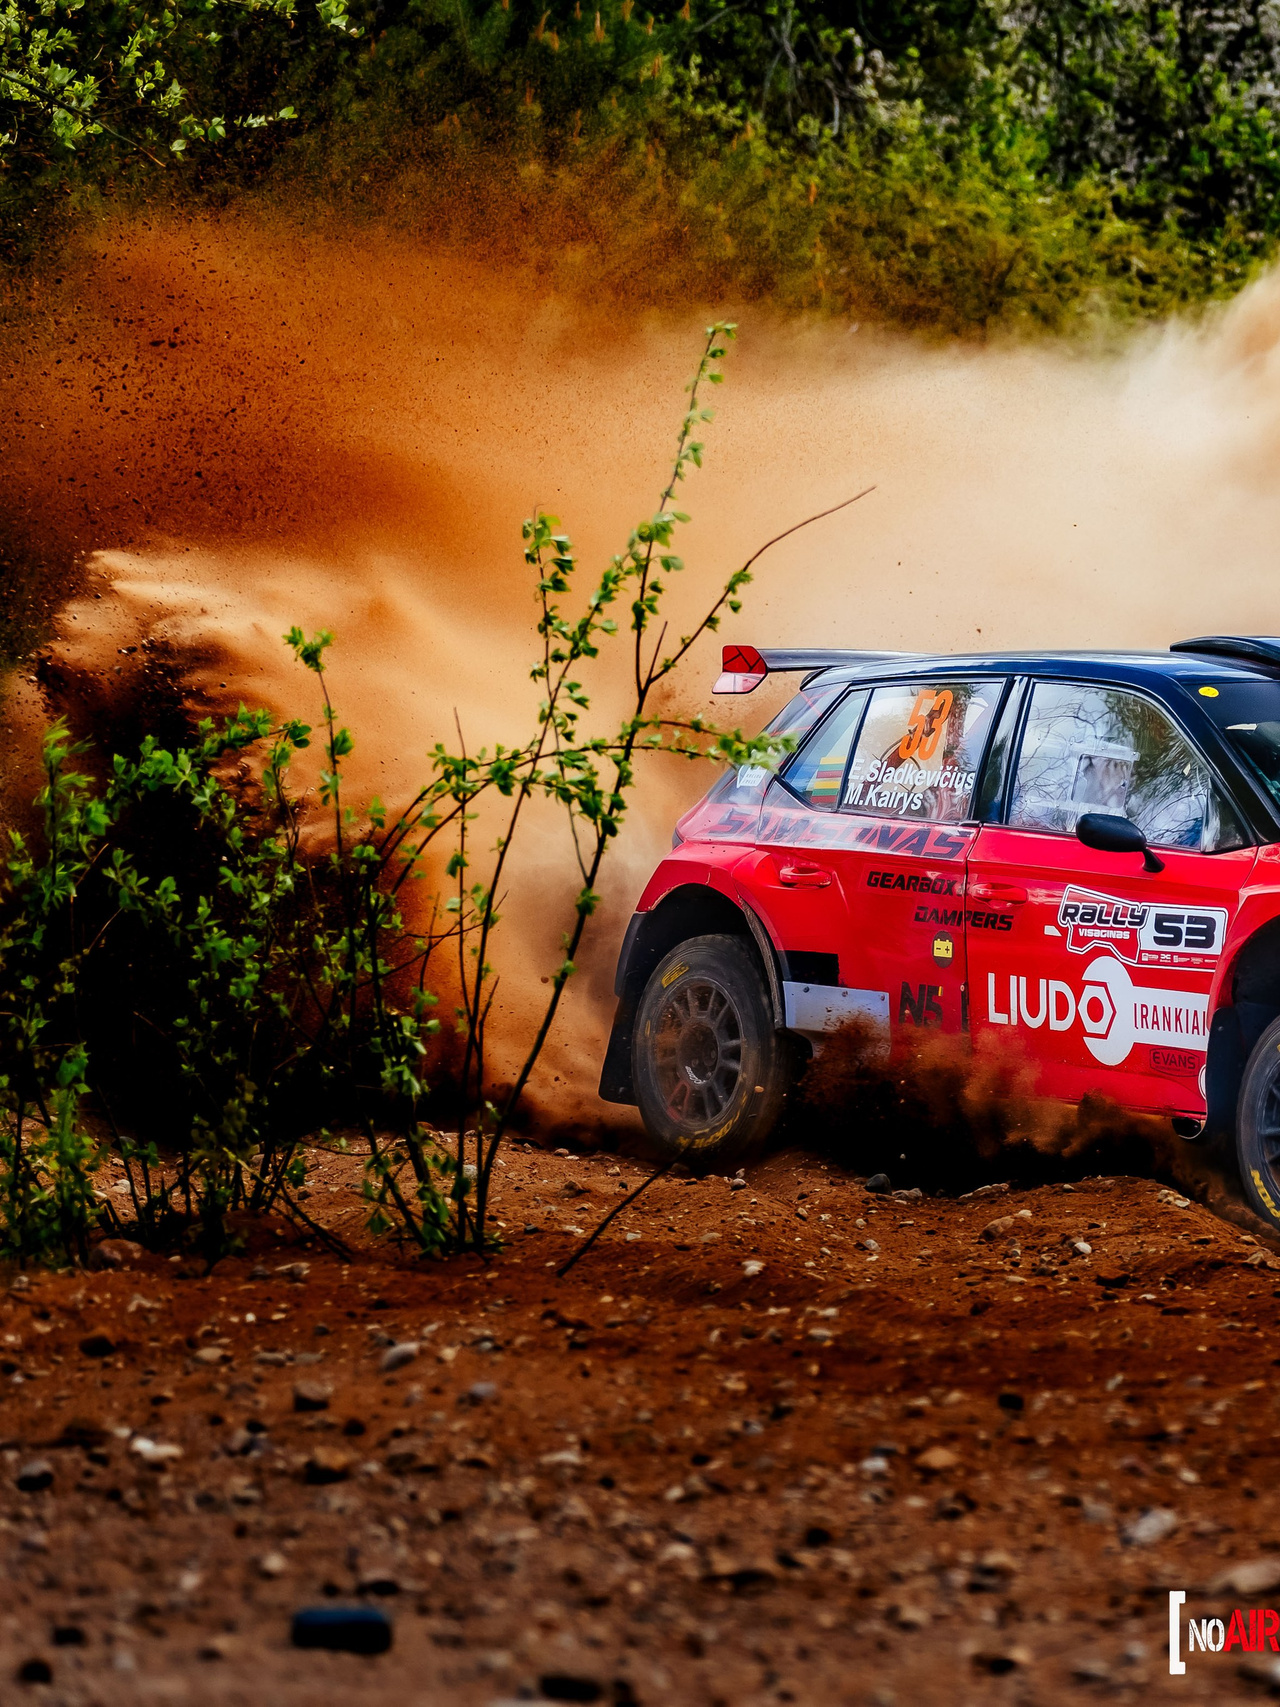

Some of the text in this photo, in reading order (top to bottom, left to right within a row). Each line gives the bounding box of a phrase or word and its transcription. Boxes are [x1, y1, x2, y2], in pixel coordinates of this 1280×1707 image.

[899, 689, 953, 760] 53
[843, 783, 924, 815] M.Kairys
[867, 871, 957, 896] GEARBOX
[914, 906, 1014, 931] DAMPERS
[1153, 913, 1217, 949] 53
[898, 981, 943, 1029] N5
[987, 972, 1114, 1036] LIUDO
[1152, 1051, 1196, 1070] EVANS
